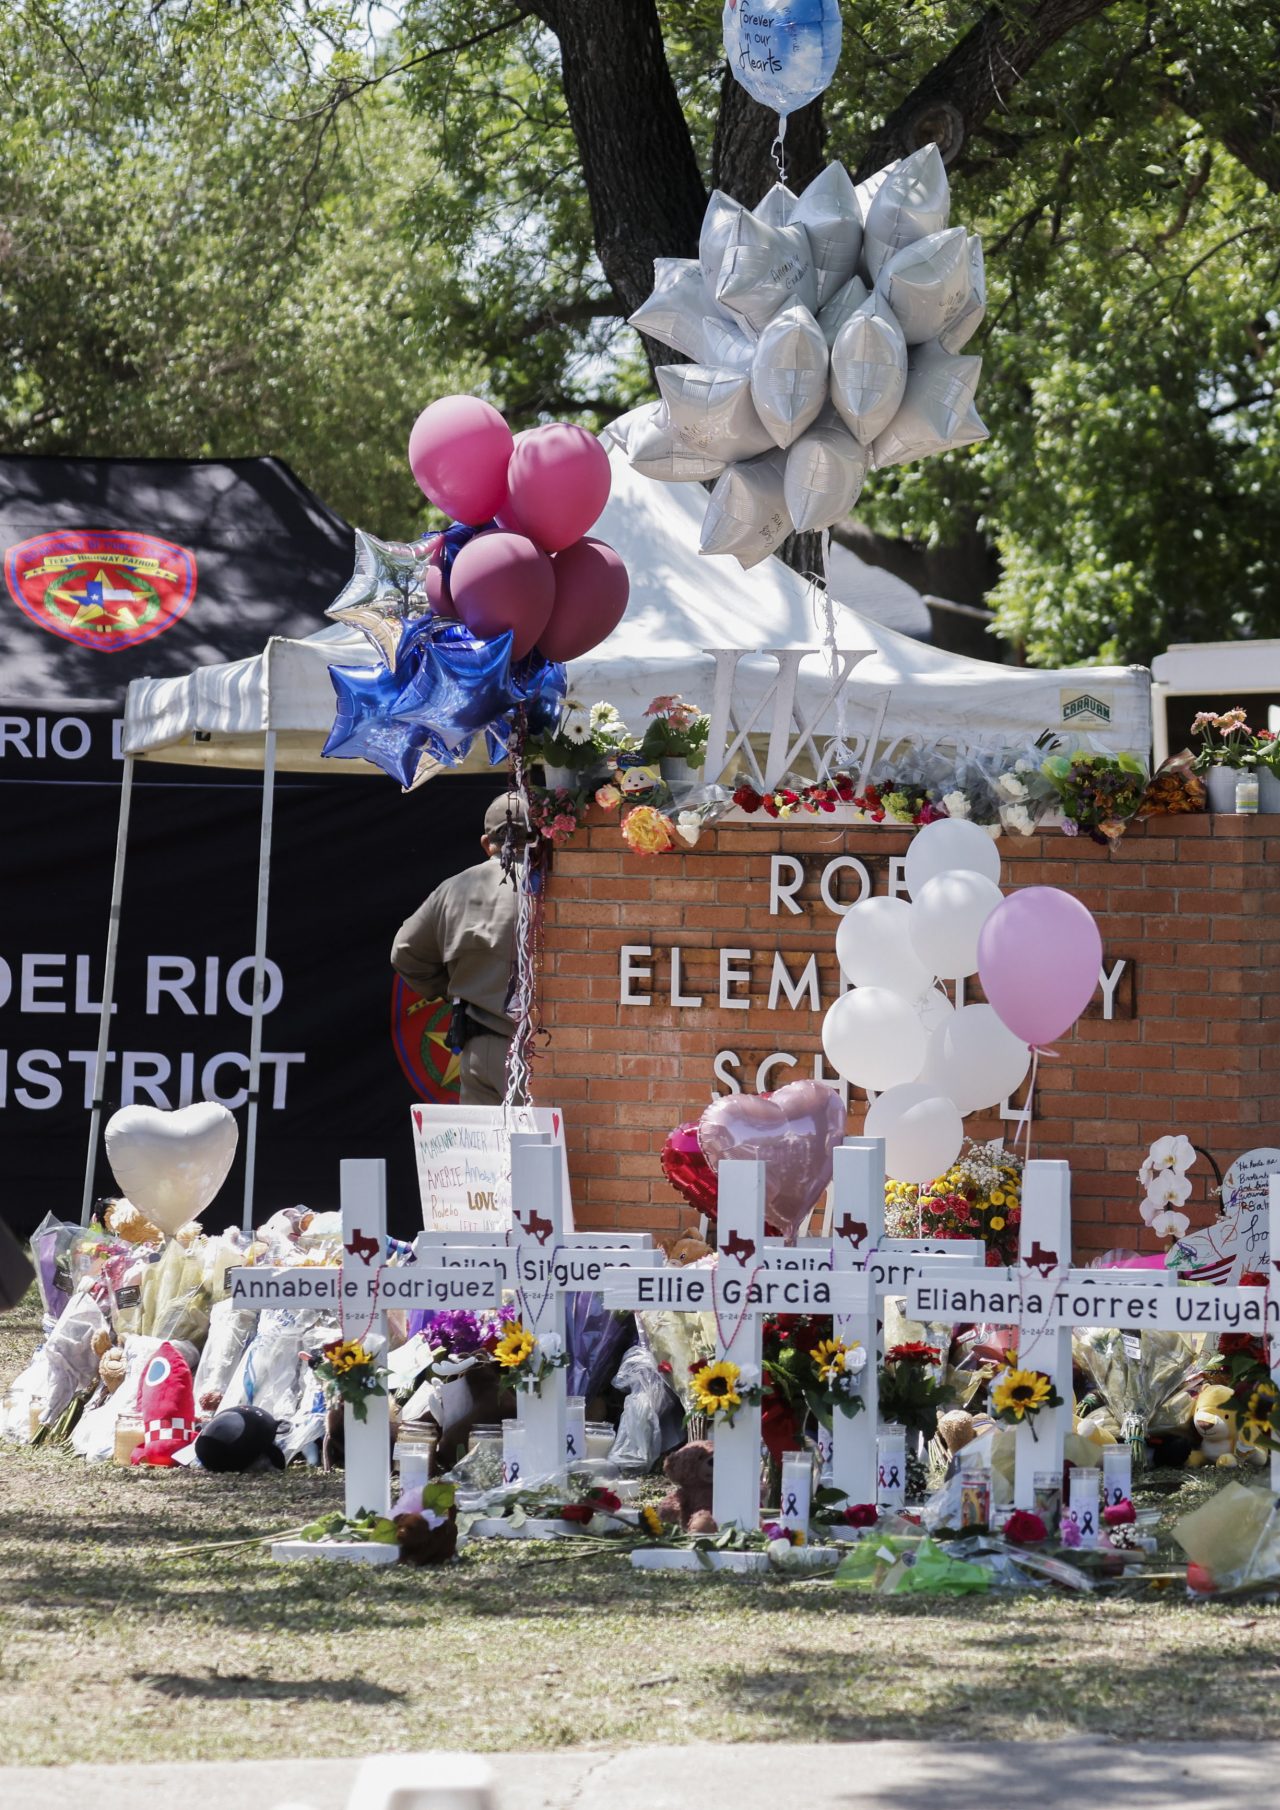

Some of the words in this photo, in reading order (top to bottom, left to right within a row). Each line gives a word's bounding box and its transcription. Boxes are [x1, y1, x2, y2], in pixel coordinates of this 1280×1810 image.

[745, 32, 751, 42] in
[754, 33, 771, 47] our
[739, 42, 783, 74] Hearts
[1063, 697, 1110, 719] CARAVAN
[0, 716, 92, 760] RIO
[146, 955, 284, 1017] RIO
[524, 1260, 632, 1287] Silgue
[367, 1278, 495, 1302] Rodriguez
[638, 1277, 704, 1303] Ellie
[723, 1278, 831, 1304] Garcia
[719, 1312, 753, 1321] 5-2422
[1055, 1293, 1158, 1319] Torres
[1176, 1296, 1280, 1327] Uziyah
